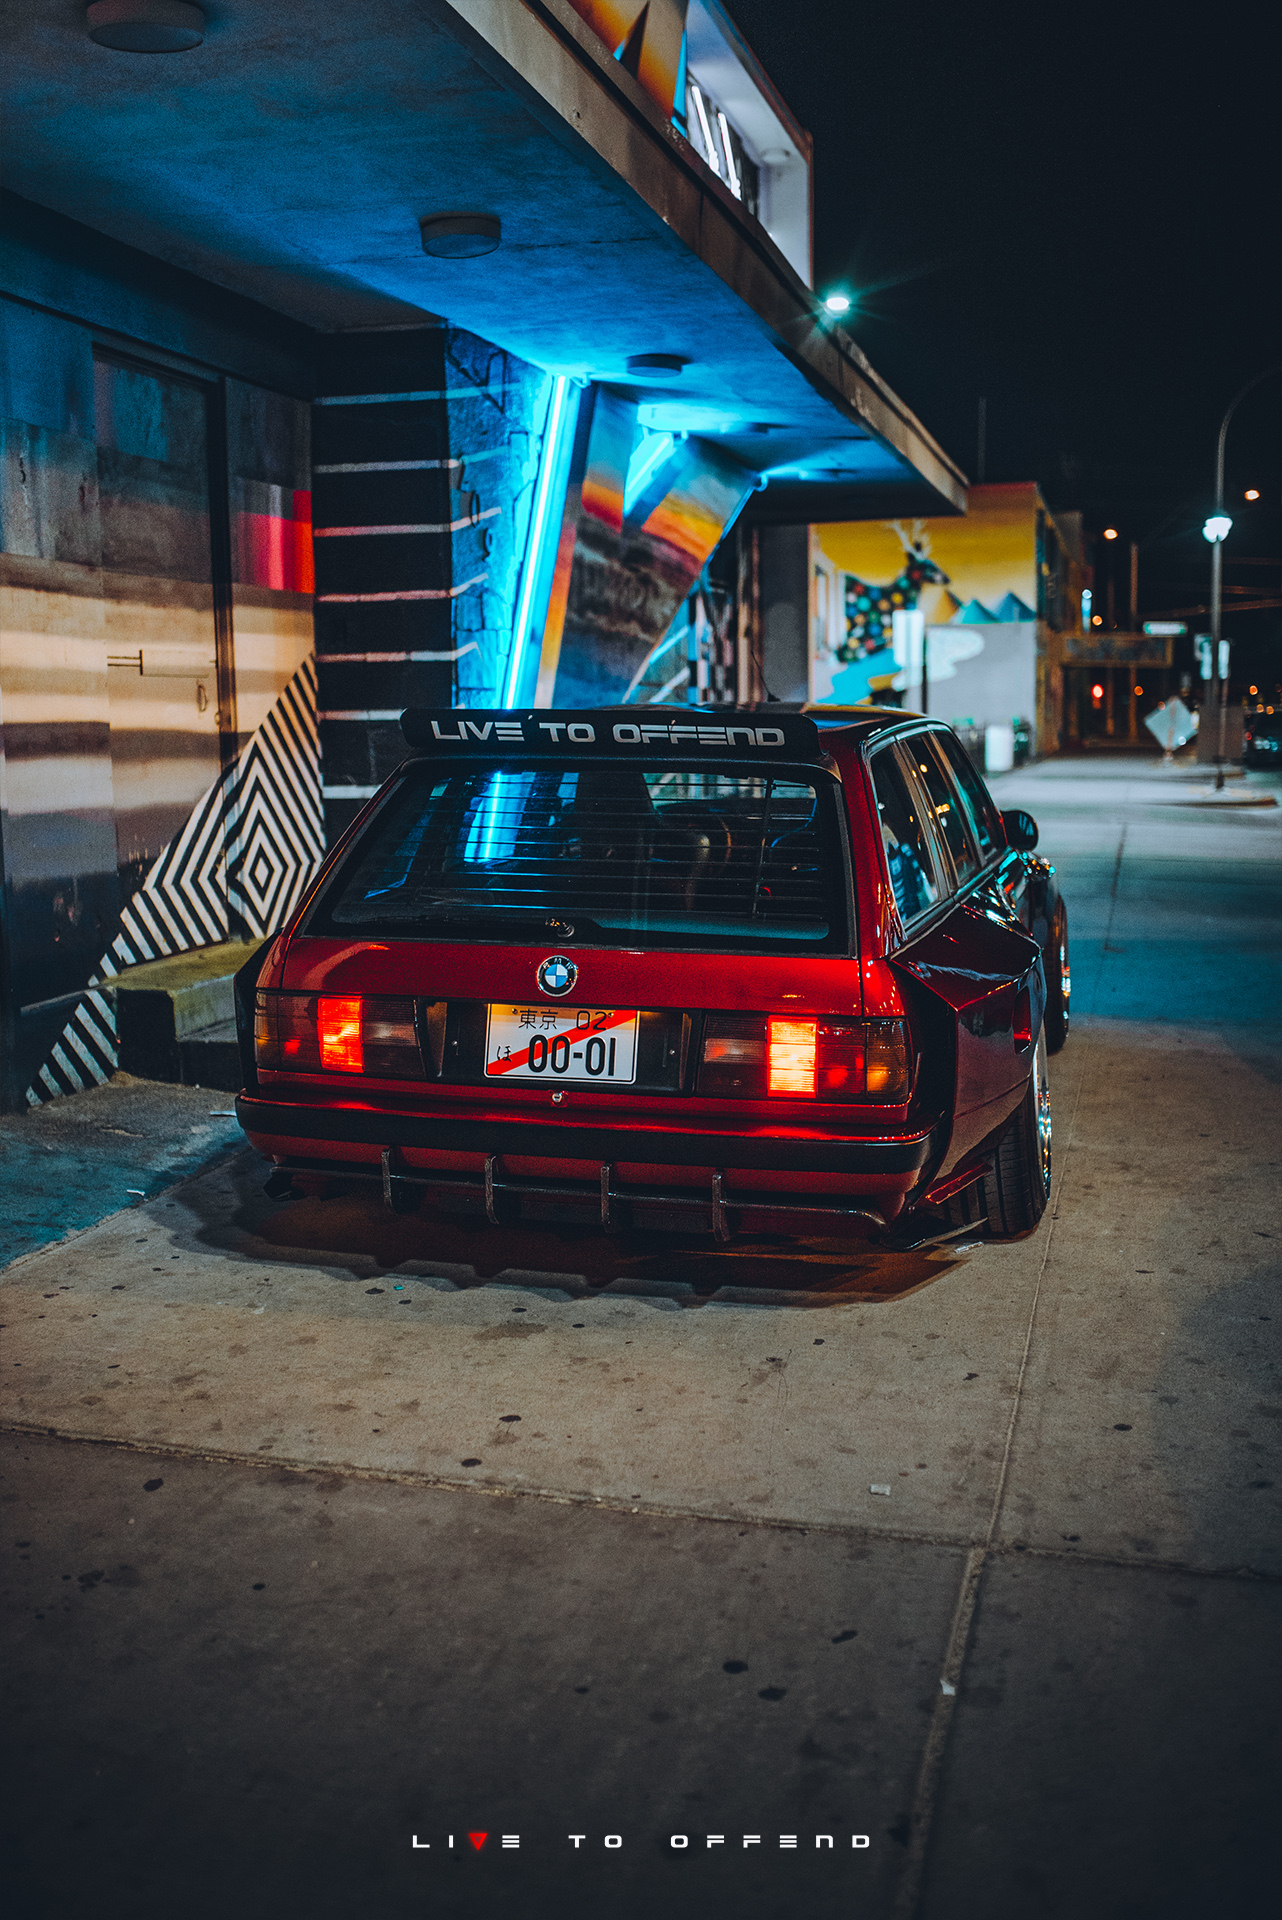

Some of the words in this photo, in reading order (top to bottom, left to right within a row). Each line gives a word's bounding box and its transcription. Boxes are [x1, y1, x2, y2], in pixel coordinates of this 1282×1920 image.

[430, 720, 525, 742] LIVE
[538, 722, 596, 743] TO
[612, 724, 786, 746] OFFEND
[543, 957, 574, 970] BMW
[518, 1009, 558, 1030] 東京
[576, 1010, 607, 1030] 02
[496, 1045, 512, 1062] ほ
[528, 1034, 616, 1076] 00-01
